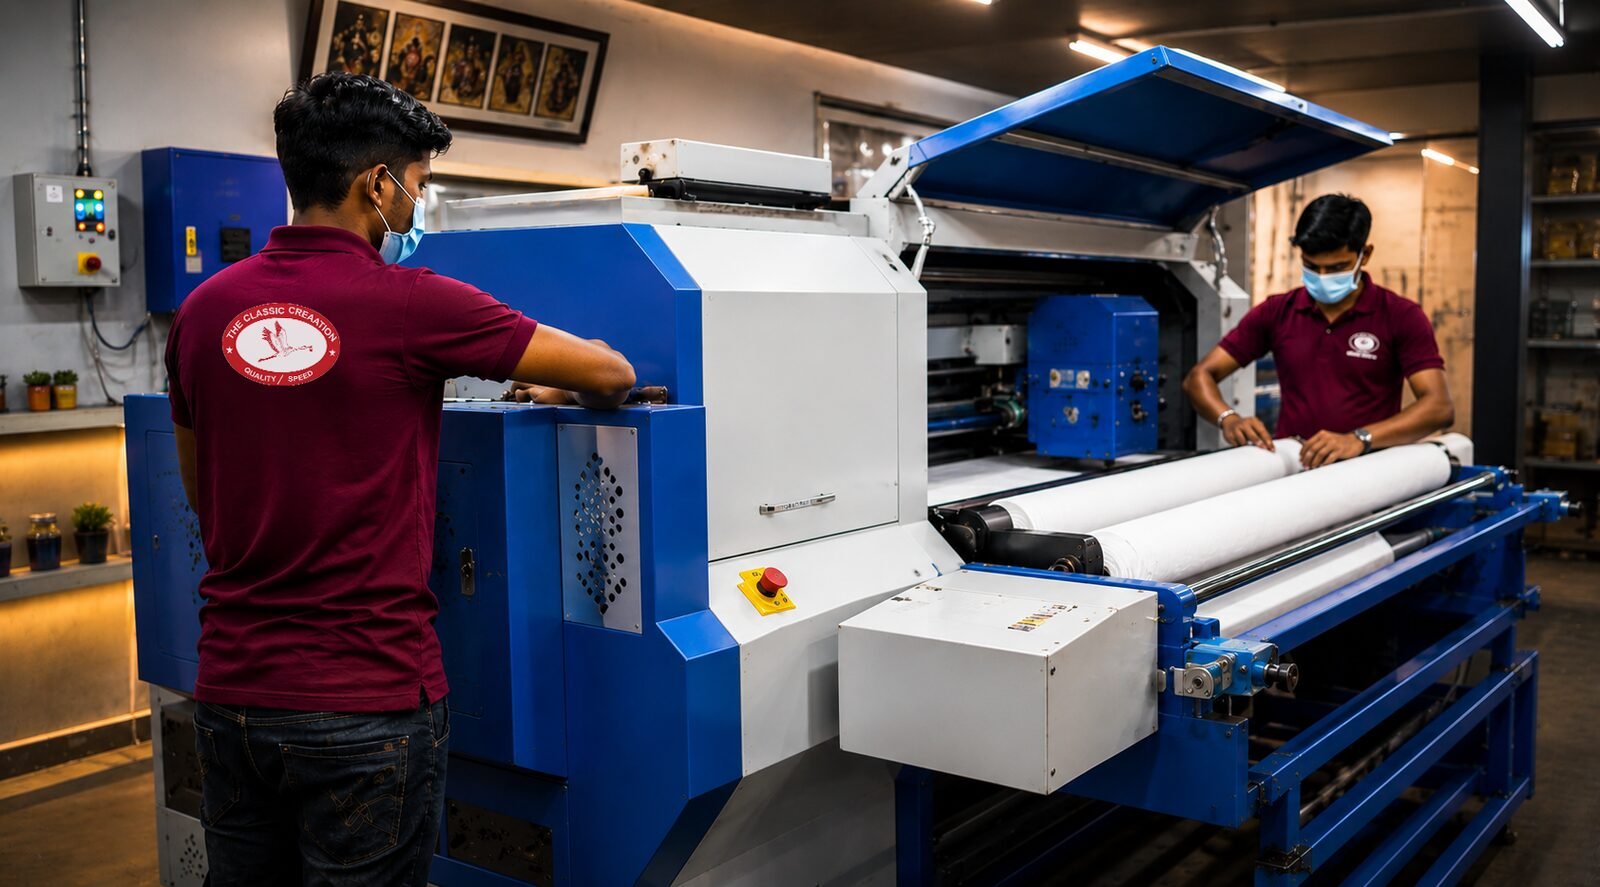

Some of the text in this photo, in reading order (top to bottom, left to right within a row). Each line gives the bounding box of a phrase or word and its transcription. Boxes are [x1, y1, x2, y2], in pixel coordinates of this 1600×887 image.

[226, 306, 337, 342] THE CLASSIC CREAATION
[288, 370, 313, 382] SPEED
